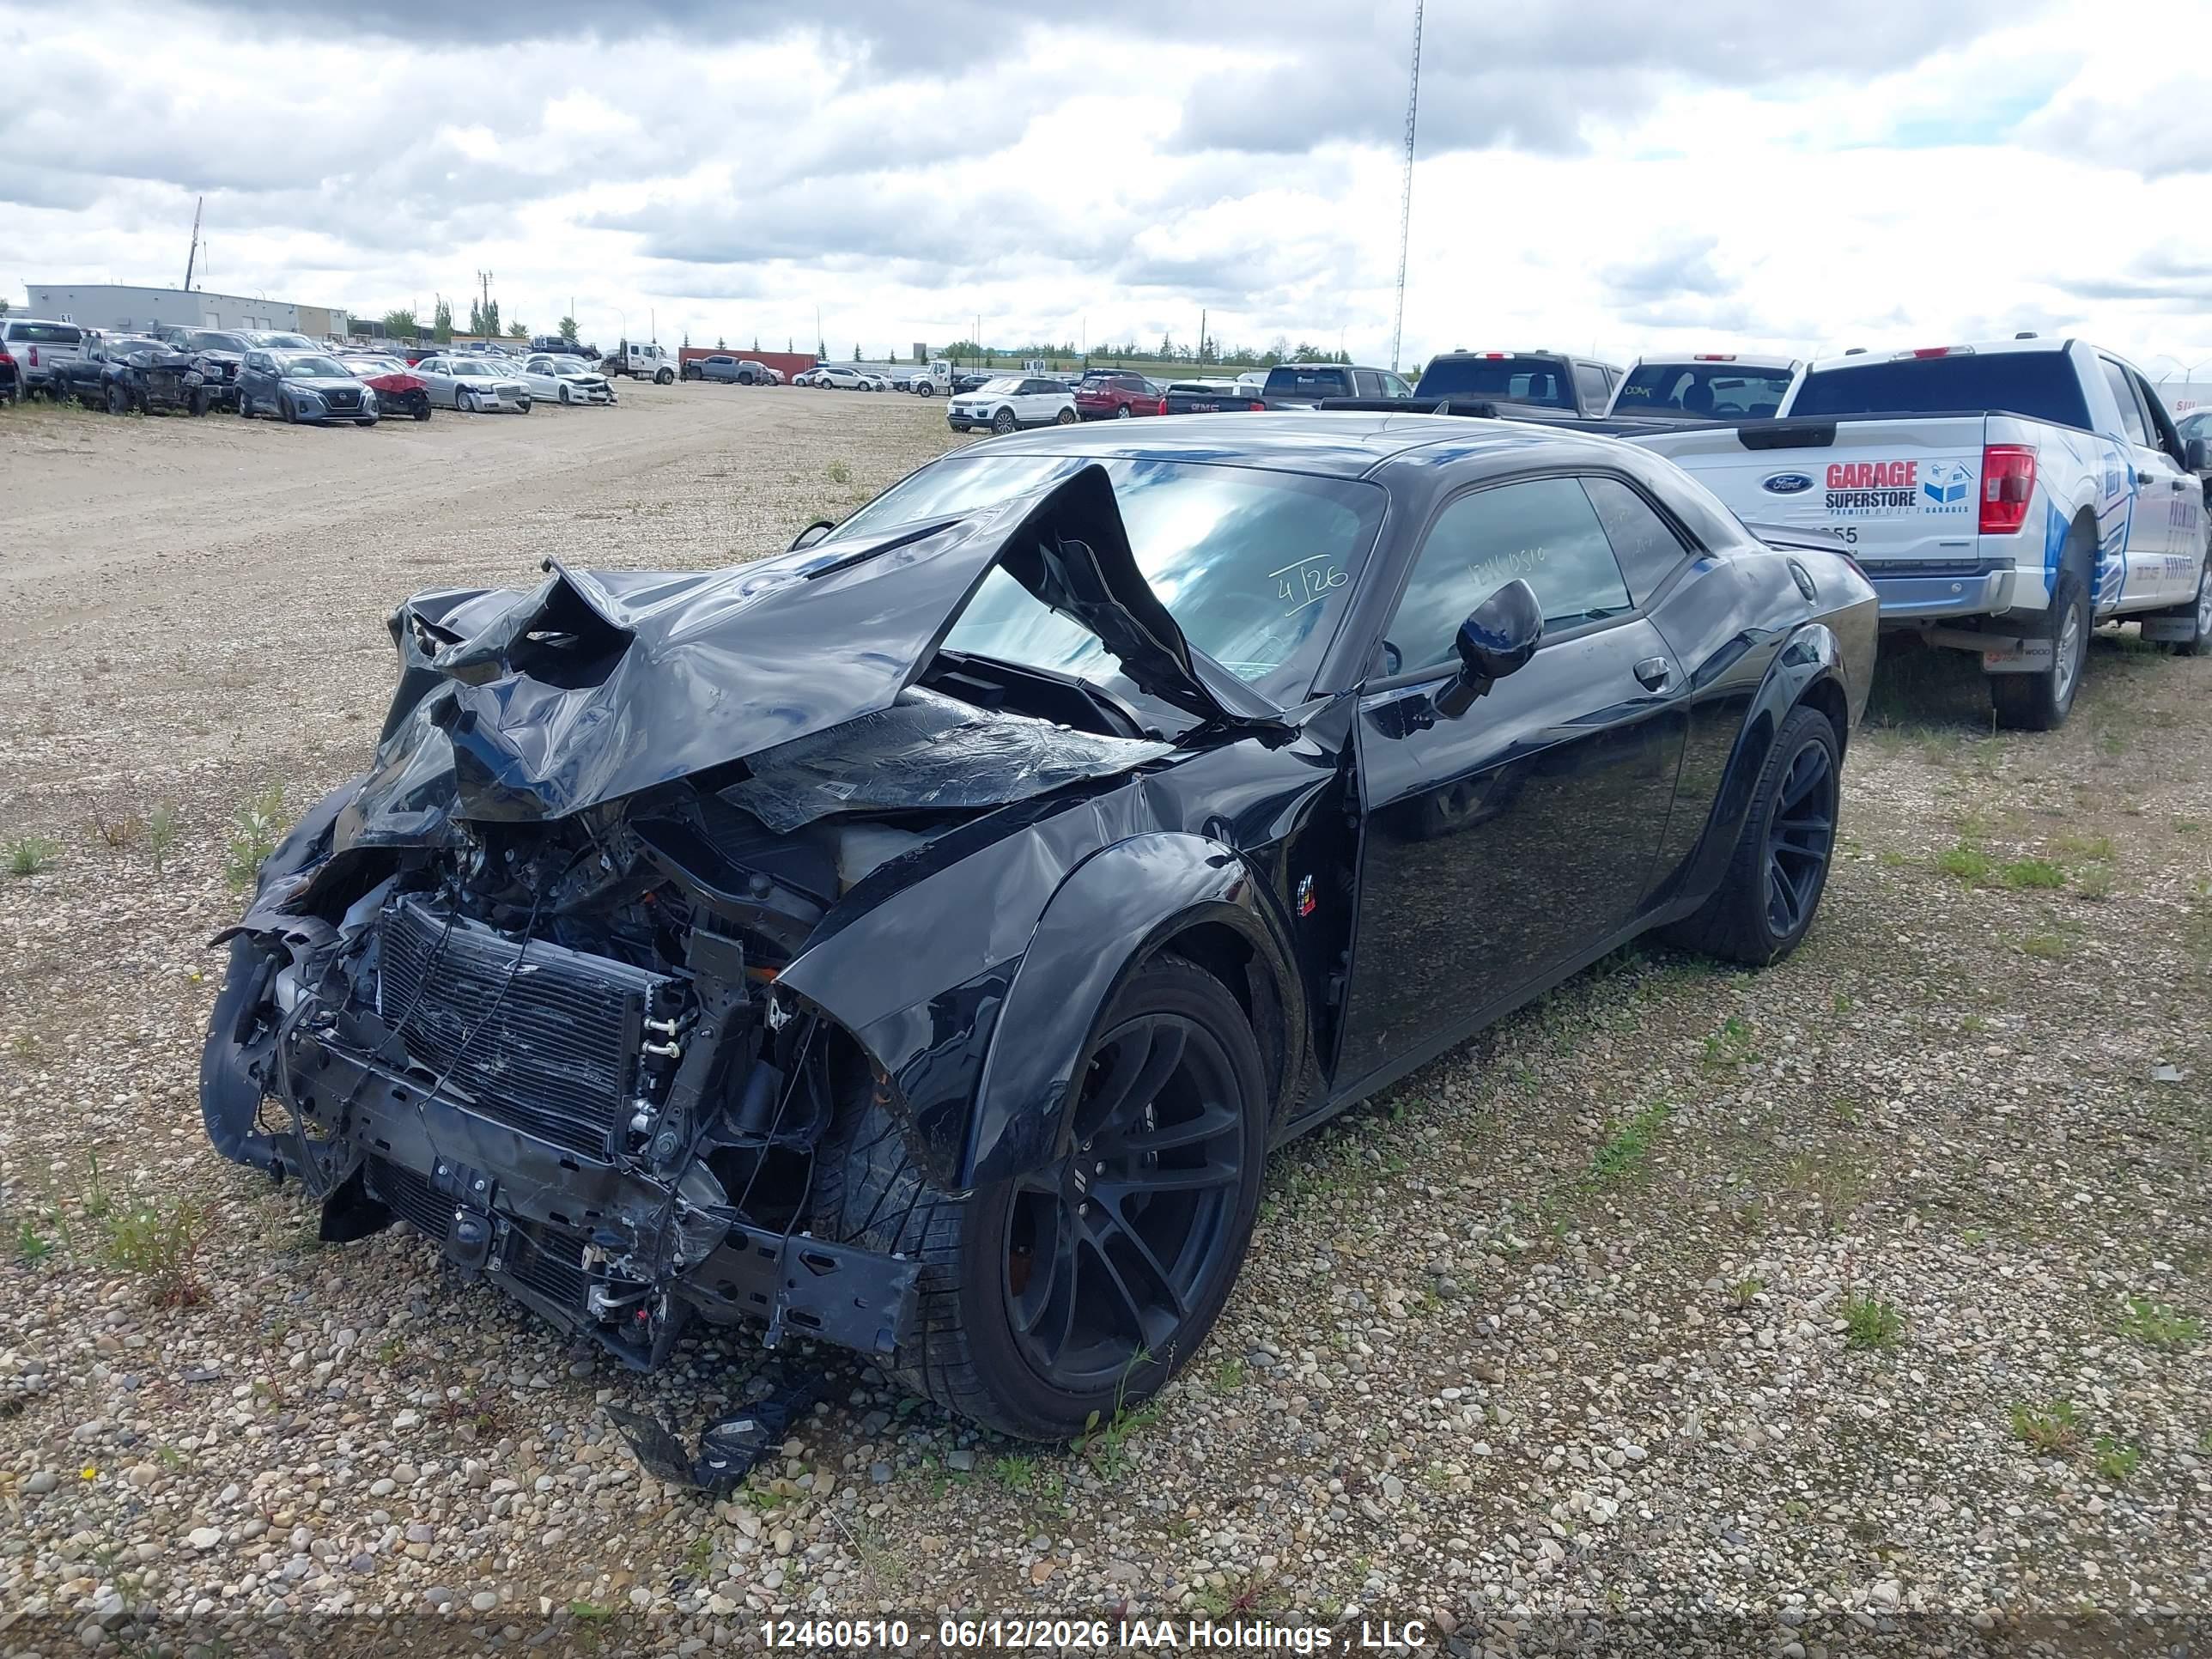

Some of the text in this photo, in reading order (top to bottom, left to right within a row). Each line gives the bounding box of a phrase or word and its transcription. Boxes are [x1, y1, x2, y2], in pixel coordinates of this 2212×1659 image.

[1191, 403, 1220, 412] GMC
[1772, 477, 1802, 490] Ford
[1826, 461, 1918, 489] GARAGE
[1826, 490, 1917, 508] SUPERSTORE
[1818, 526, 1858, 544] 55
[1279, 565, 1349, 604] 4/26
